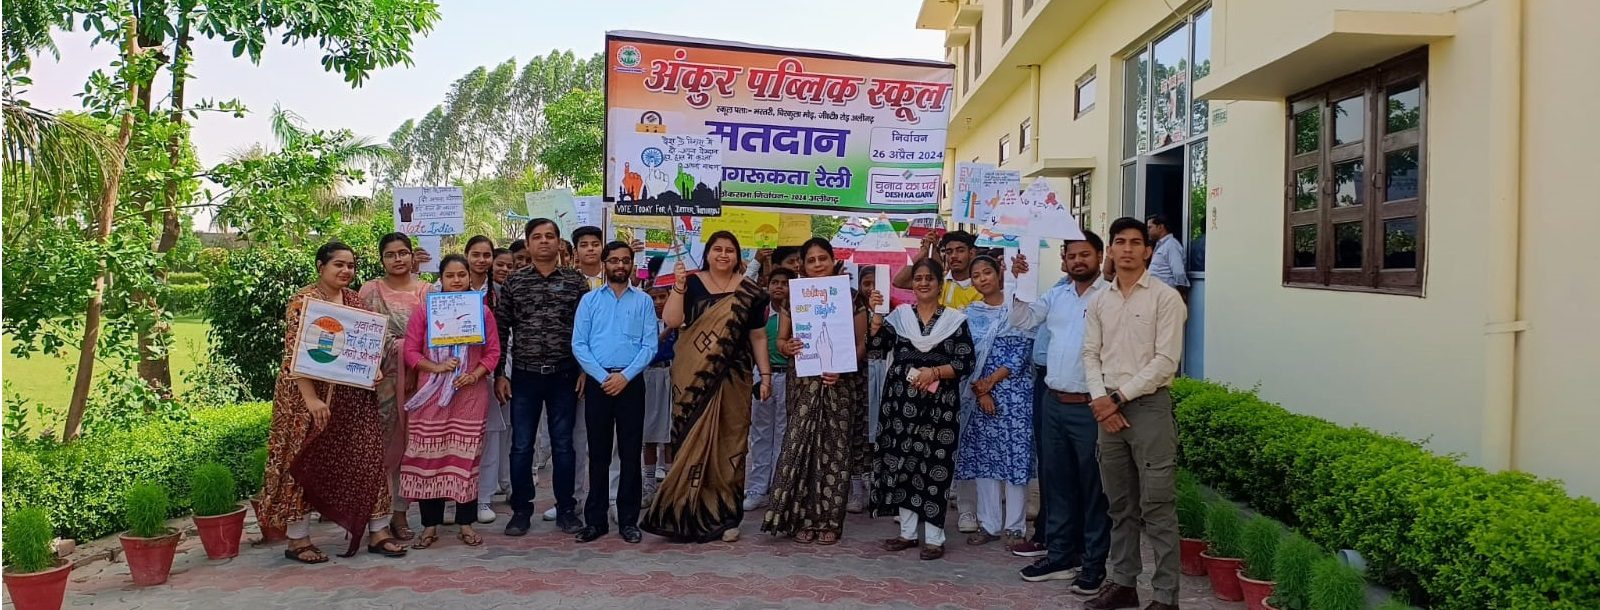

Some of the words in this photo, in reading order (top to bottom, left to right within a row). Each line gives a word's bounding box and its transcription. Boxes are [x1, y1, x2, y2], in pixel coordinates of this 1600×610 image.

[644, 49, 743, 109] अंकुर
[747, 57, 865, 107] पब्लिक
[867, 78, 952, 124] स्कूल
[705, 121, 850, 157] मतदान
[892, 130, 928, 142] निर्वाचन
[873, 150, 885, 158] 26
[889, 148, 914, 159] अप्रैल
[919, 151, 943, 159] 2024
[815, 165, 852, 188] रैली
[875, 181, 903, 193] चुनाव
[905, 182, 920, 190] का
[921, 178, 938, 190] पर्व
